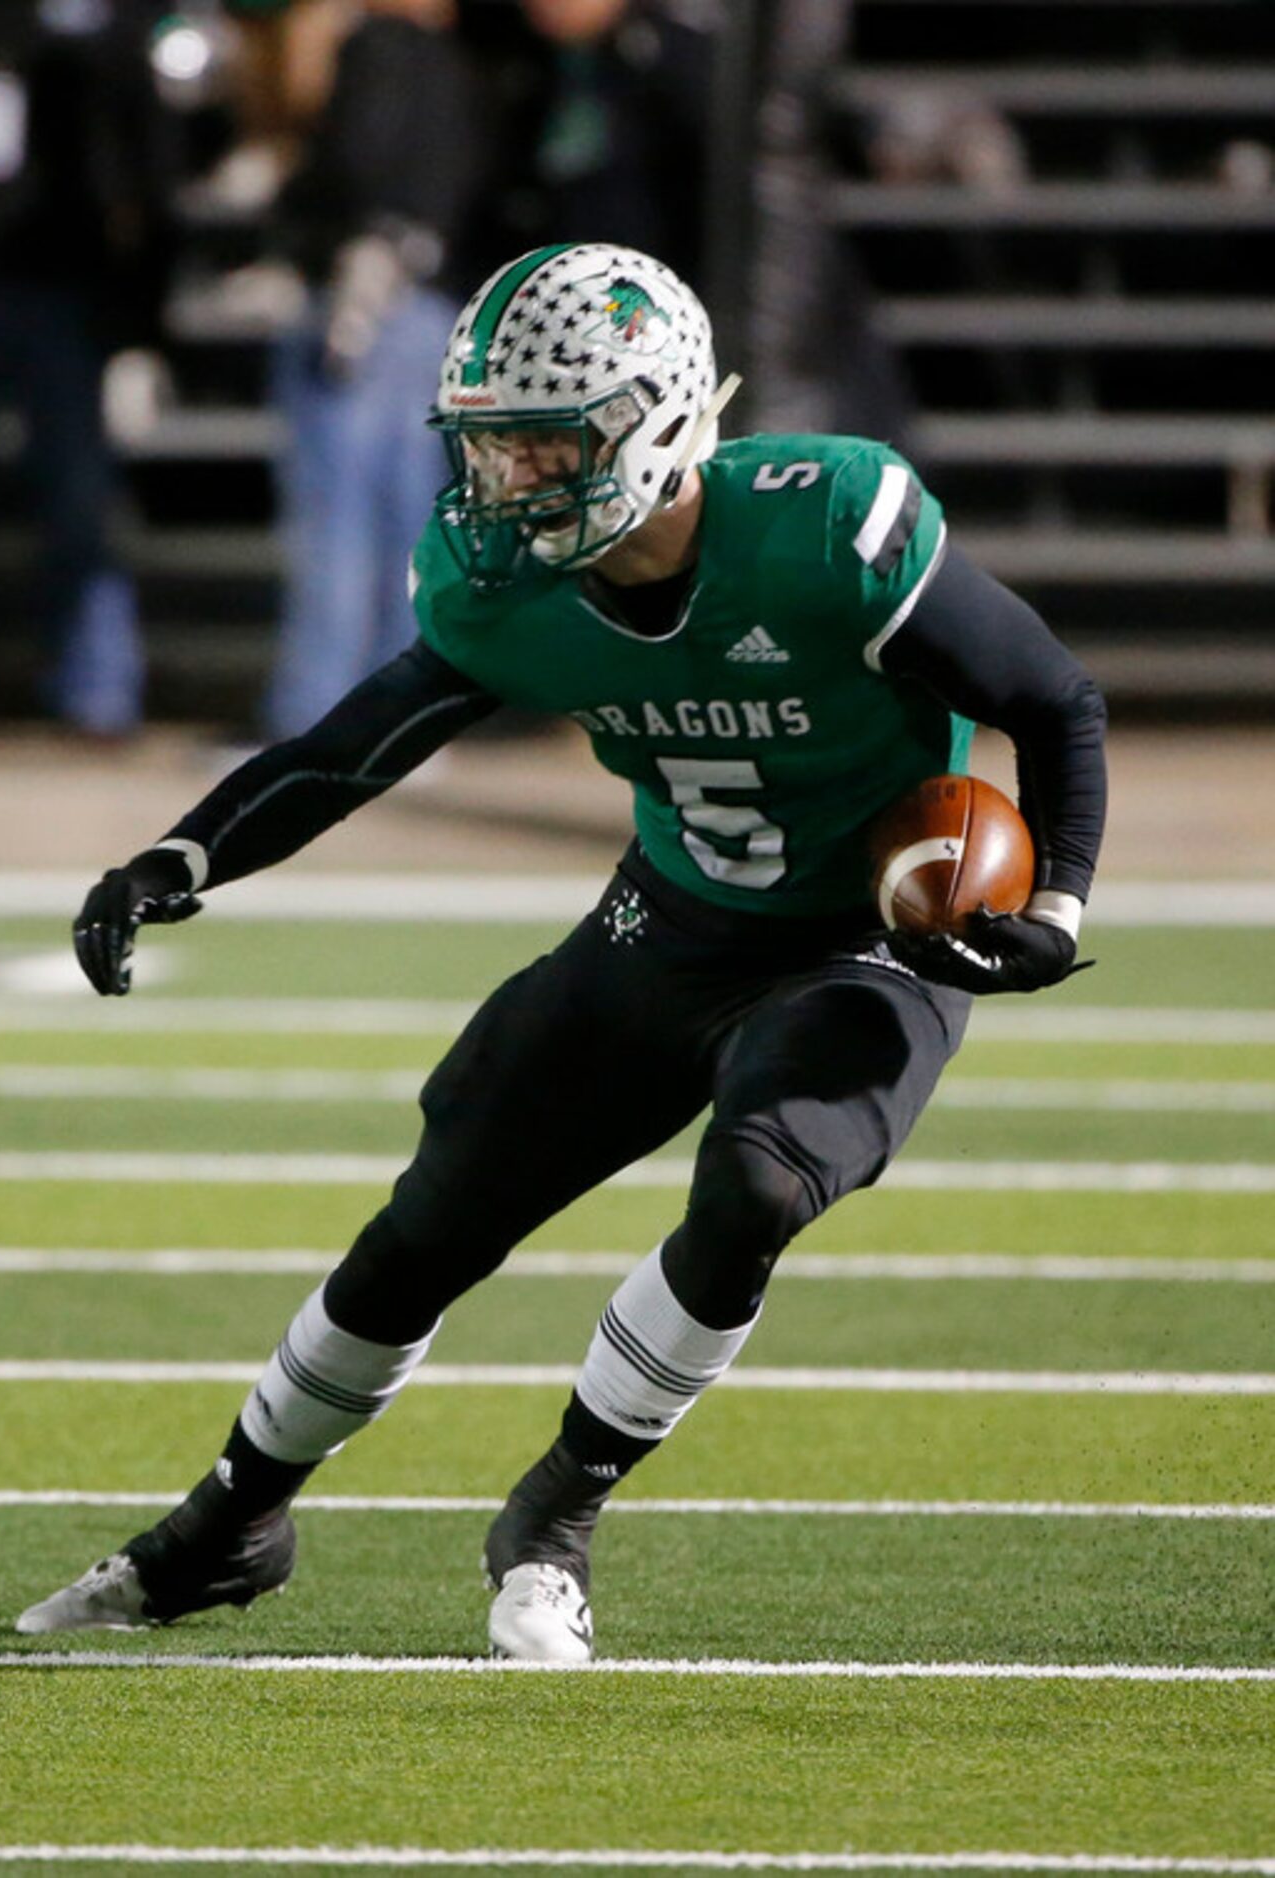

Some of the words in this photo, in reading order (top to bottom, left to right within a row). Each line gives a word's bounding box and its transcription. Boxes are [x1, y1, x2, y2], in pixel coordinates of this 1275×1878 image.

[752, 461, 822, 491] 5
[571, 696, 812, 739] DRAGONS
[656, 756, 787, 889] 5
